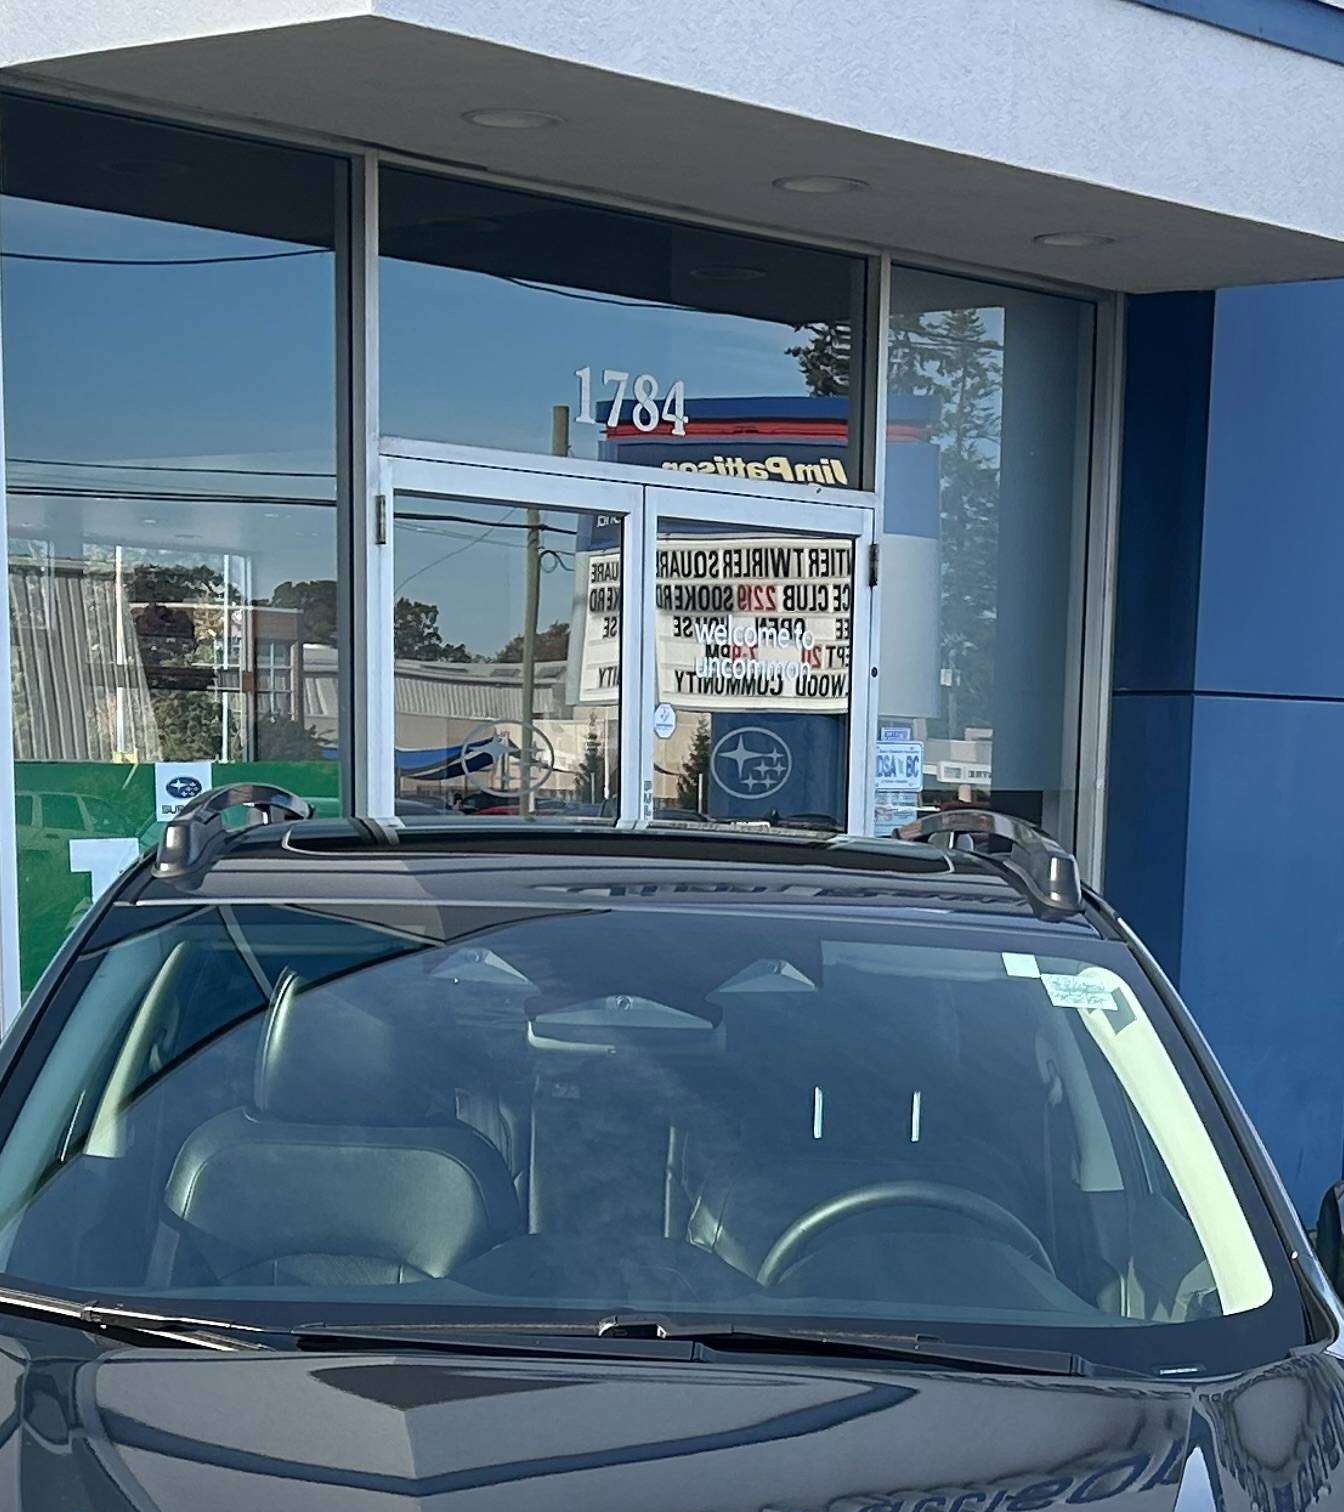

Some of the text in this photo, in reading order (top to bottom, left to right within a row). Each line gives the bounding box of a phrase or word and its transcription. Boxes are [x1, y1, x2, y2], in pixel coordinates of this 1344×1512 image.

[575, 366, 689, 436] 1784
[694, 614, 815, 649] welcome to
[694, 656, 811, 682] uncommon
